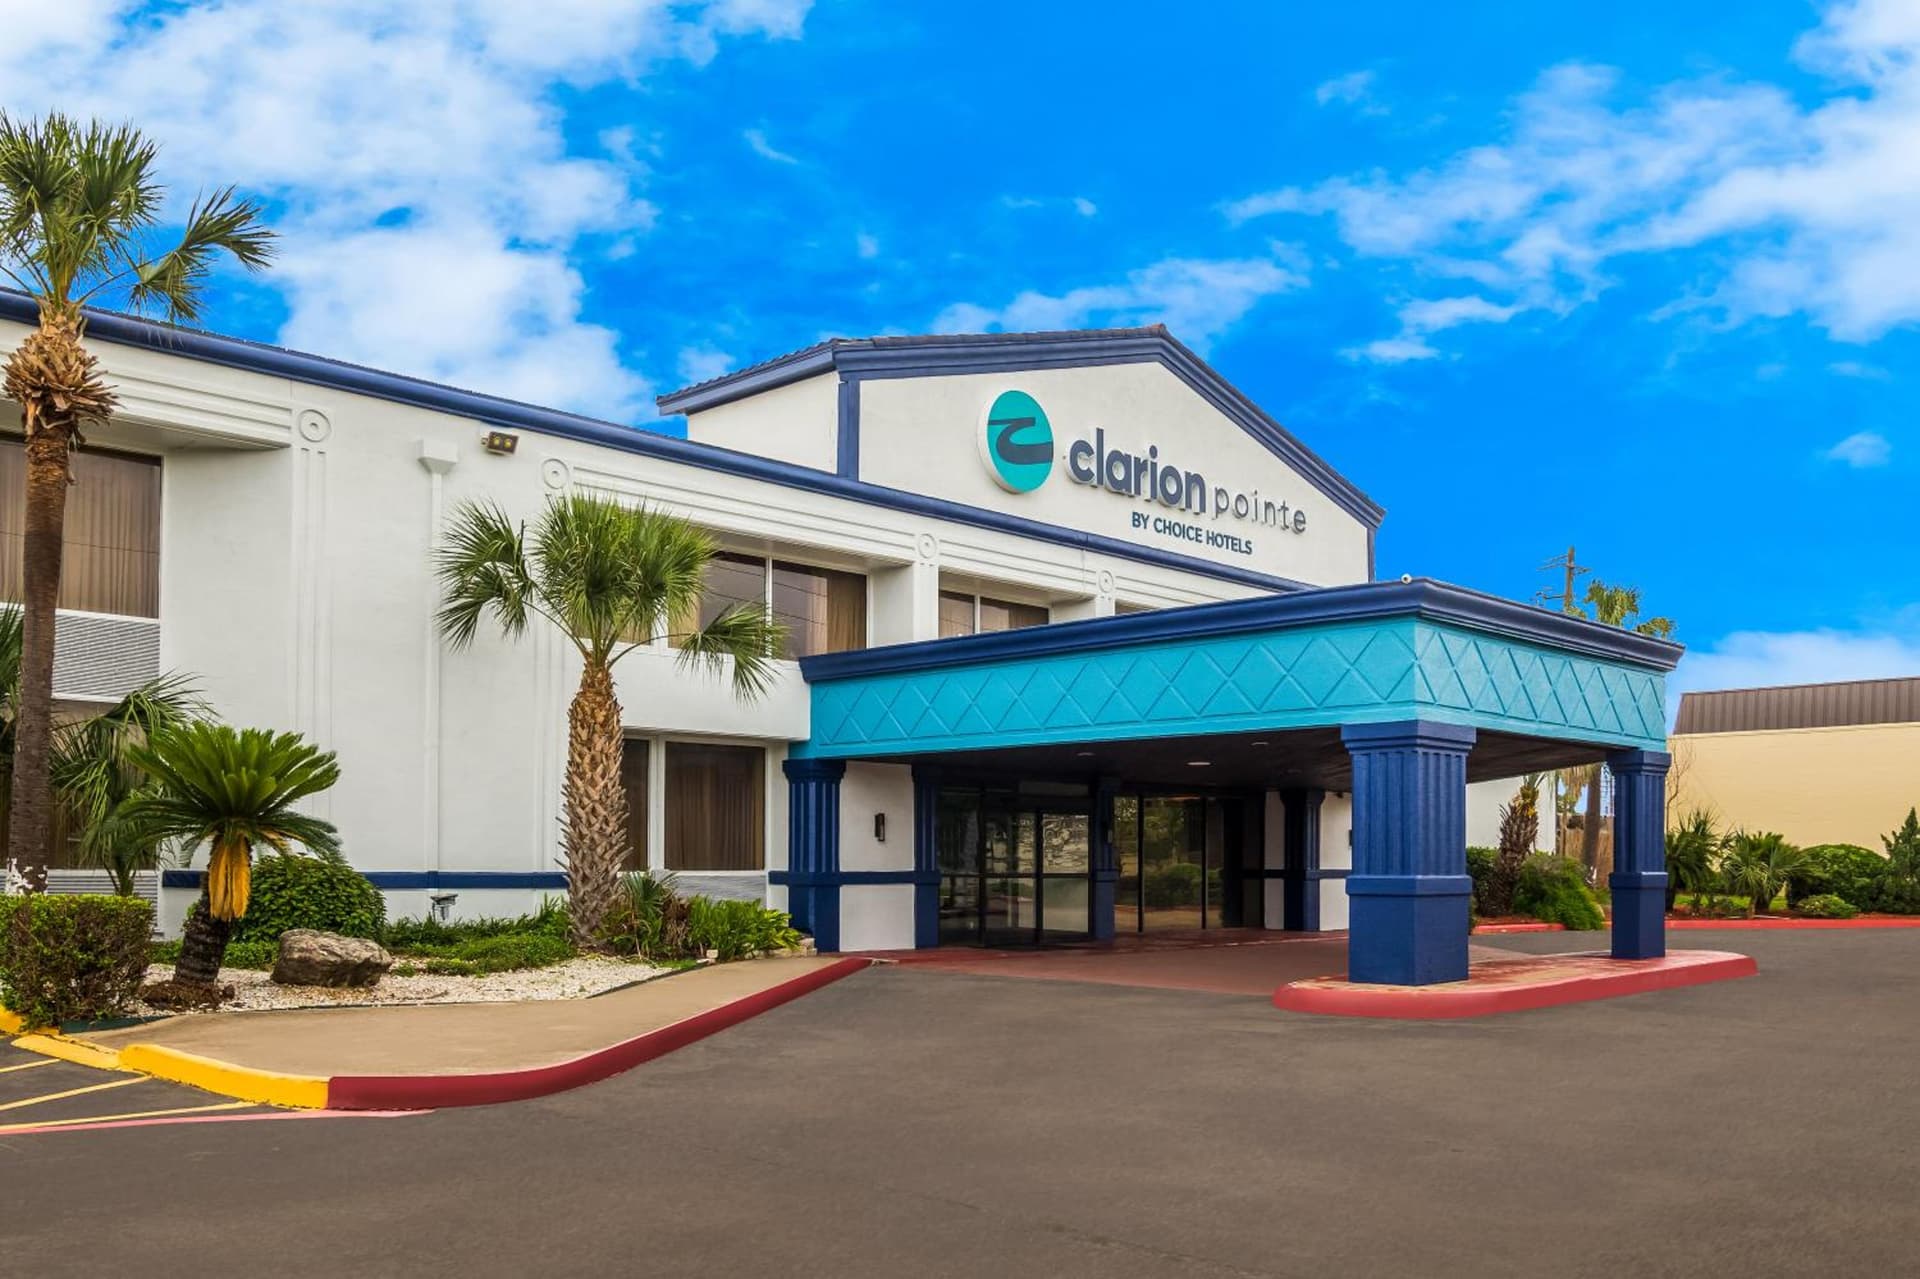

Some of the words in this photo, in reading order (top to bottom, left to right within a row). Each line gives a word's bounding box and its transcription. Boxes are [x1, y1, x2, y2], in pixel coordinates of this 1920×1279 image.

[1068, 428, 1206, 514] clarion
[1213, 487, 1306, 533] pointe
[1132, 511, 1150, 529] BY
[1154, 518, 1203, 544] CHOICE
[1206, 531, 1252, 555] HOTELS
